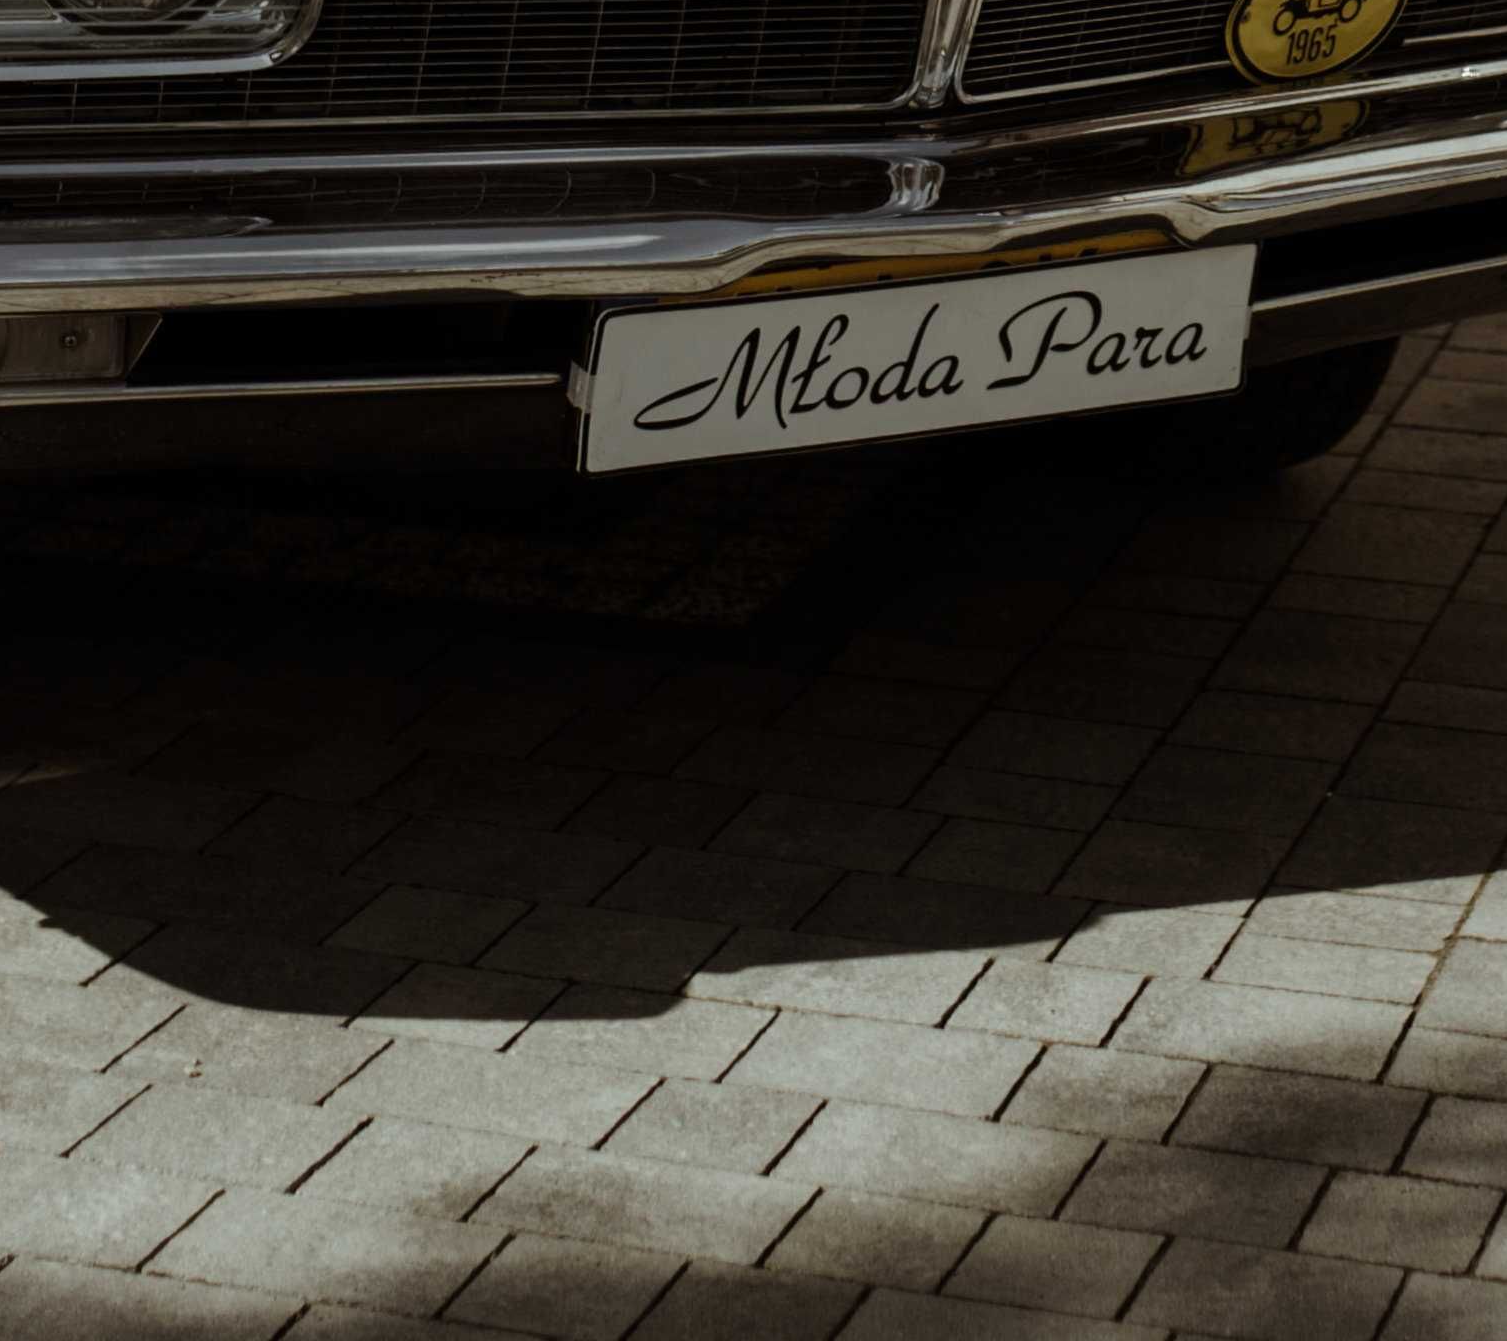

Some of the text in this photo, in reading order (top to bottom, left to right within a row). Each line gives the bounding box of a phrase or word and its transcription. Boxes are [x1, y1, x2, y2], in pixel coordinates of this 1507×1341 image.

[1285, 18, 1338, 66] 1965
[633, 290, 1207, 431] Młoda Para
